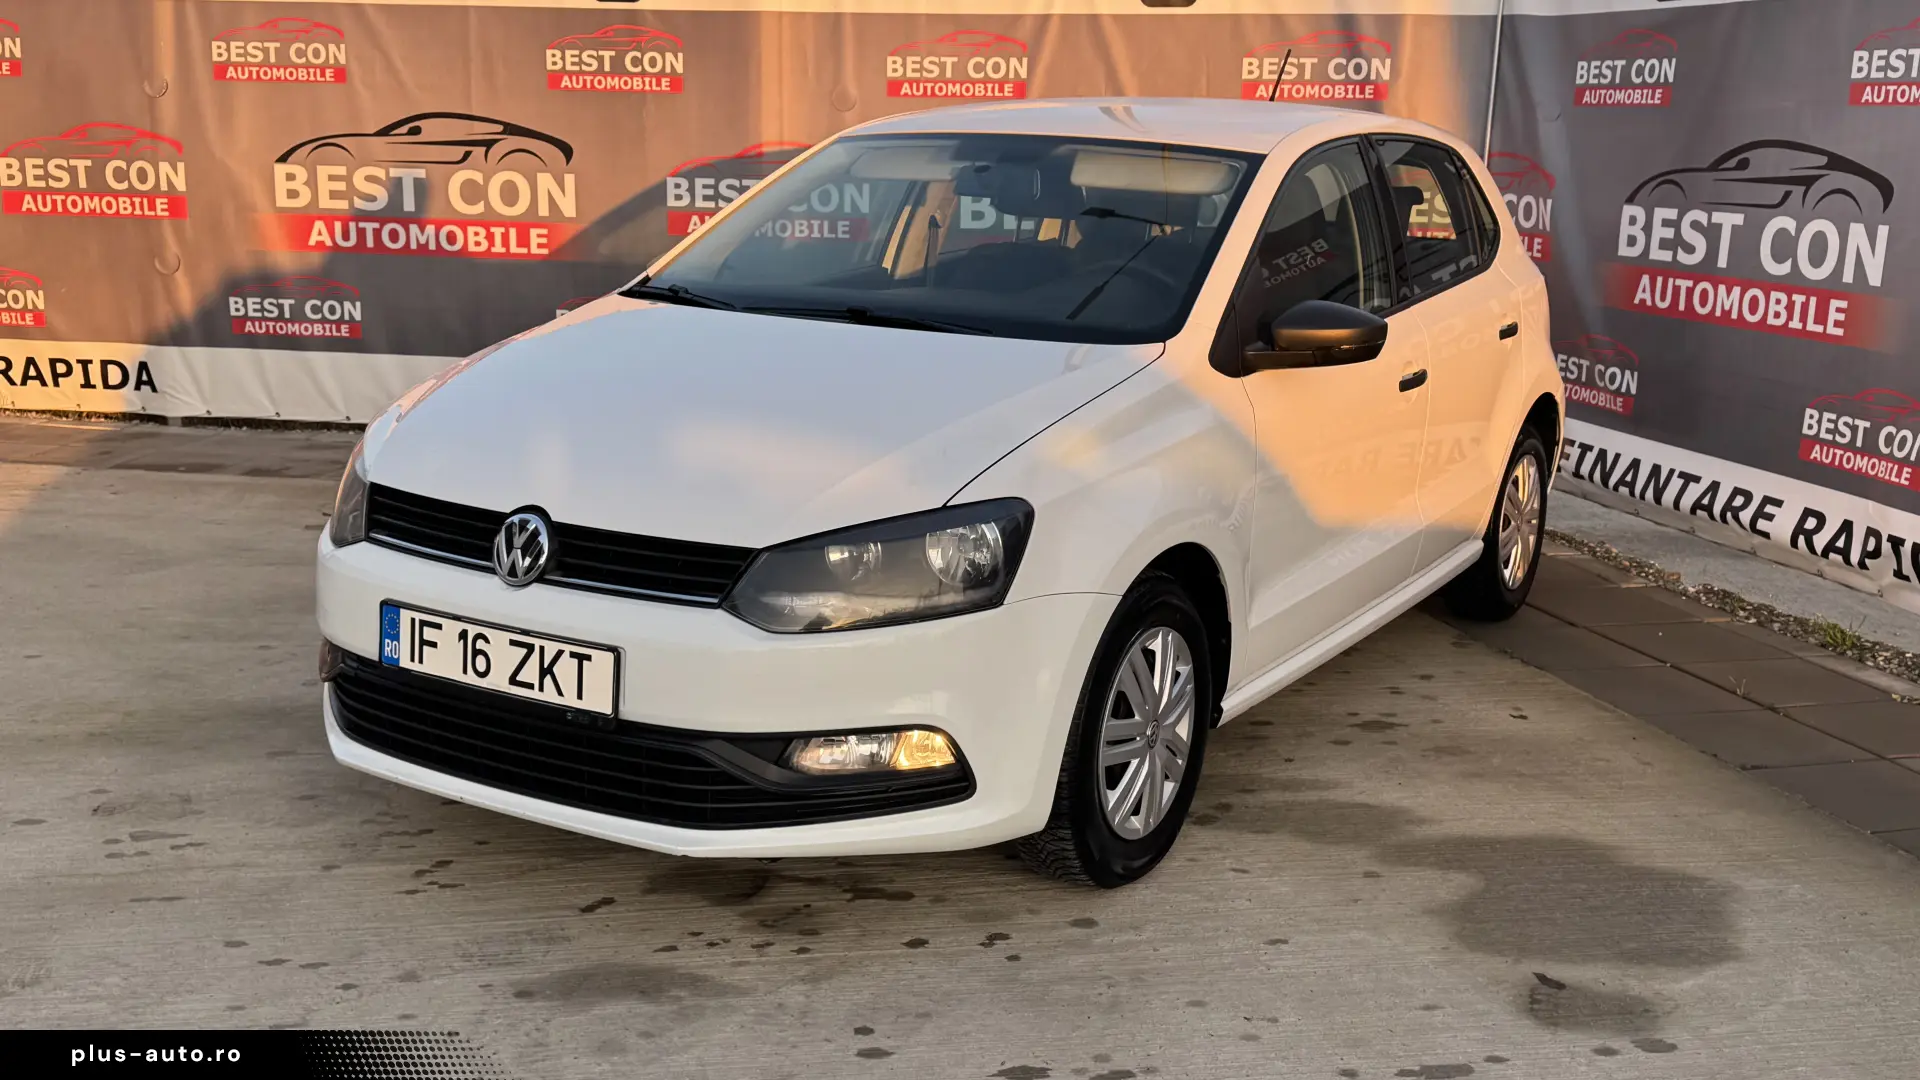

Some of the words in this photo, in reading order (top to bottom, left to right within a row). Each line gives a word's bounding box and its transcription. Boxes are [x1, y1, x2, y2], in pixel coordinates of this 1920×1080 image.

[212, 41, 280, 62] BEST
[289, 43, 346, 64] CON
[546, 49, 615, 71] BEST
[624, 51, 684, 73] CON
[225, 67, 335, 82] AUTOMOBILE
[886, 56, 957, 78] BEST
[967, 57, 1028, 79] CON
[1241, 57, 1317, 80] BEST
[1327, 58, 1391, 80] CON
[1575, 60, 1625, 84] BEST
[1630, 58, 1676, 83] CON
[560, 75, 671, 91] AUTOMOBILE
[900, 83, 1014, 97] AUTOMOBILE
[1255, 84, 1374, 99] AUTOMOBILE
[1582, 88, 1663, 104] AUTOMOBILE
[0, 157, 92, 189] BEST
[105, 160, 187, 191] CON
[274, 163, 426, 212] BEST
[447, 168, 577, 218] CON
[21, 195, 170, 216] AUTOMOBILE
[308, 220, 549, 255] AUTOMOBILE
[1617, 204, 1745, 268] BEST
[1760, 215, 1890, 287] CON
[229, 296, 295, 319] BEST
[304, 299, 362, 321] CON
[1633, 274, 1848, 336] AUTOMOBILE
[244, 321, 350, 337] AUTOMOBILE
[0, 355, 158, 393] RAPIDA
[1594, 364, 1638, 395] CON
[1802, 408, 1871, 448] BEST
[1809, 444, 1912, 486] AUTOMOBILE
[1556, 437, 1785, 540] FINANTARE
[385, 638, 399, 658] RO
[410, 617, 443, 664] IF
[457, 628, 491, 679] 16
[508, 639, 592, 701] ZKT
